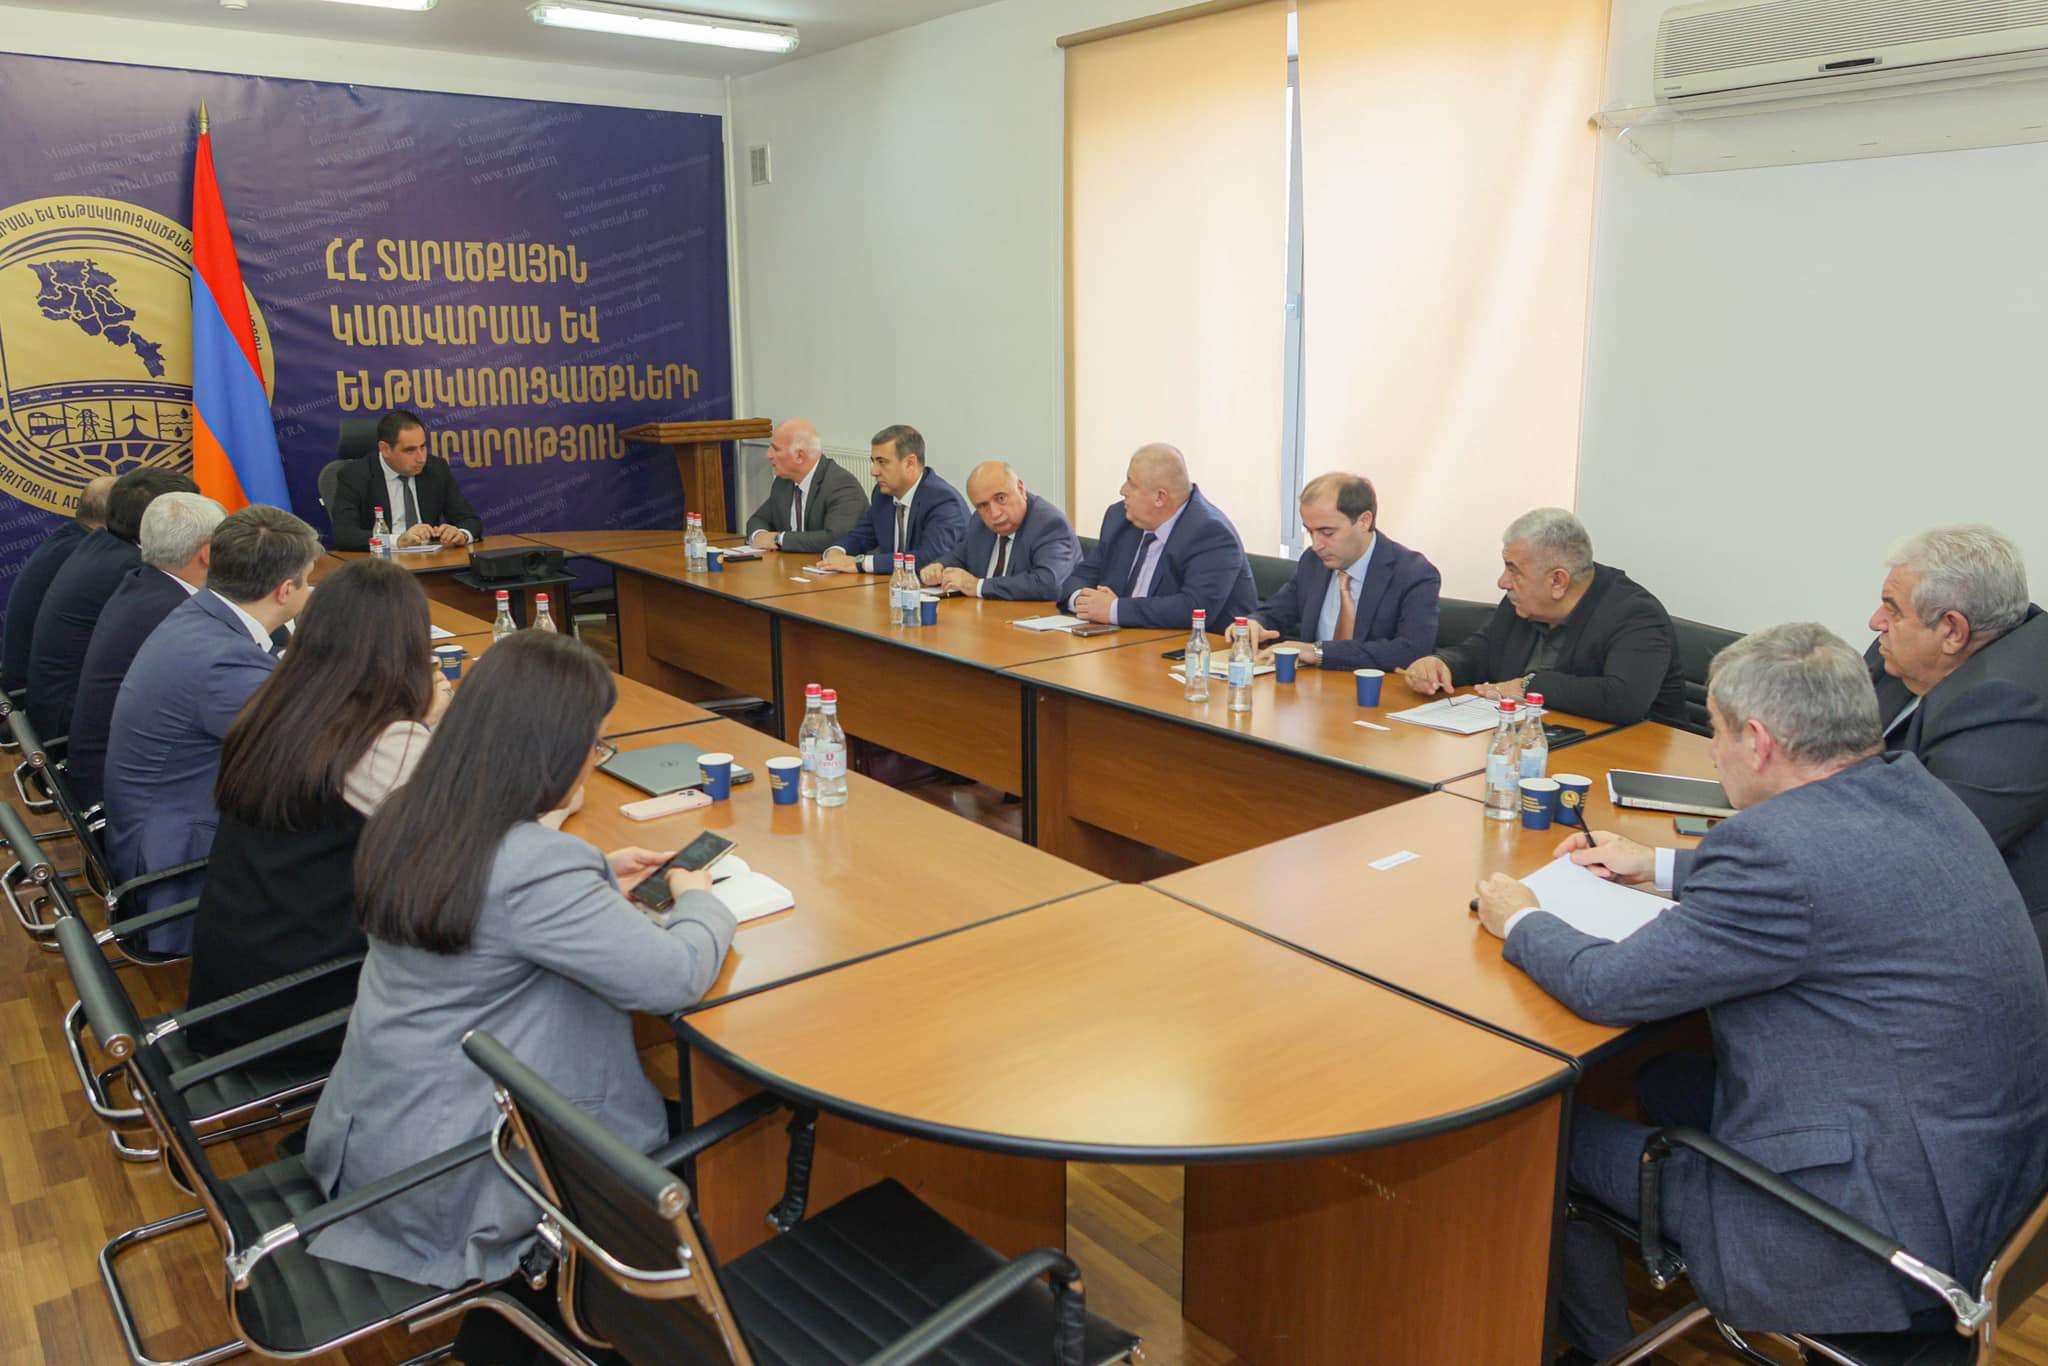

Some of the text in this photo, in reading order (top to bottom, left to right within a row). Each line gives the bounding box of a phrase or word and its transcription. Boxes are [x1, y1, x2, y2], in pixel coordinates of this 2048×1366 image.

[325, 237, 367, 282] ՀՀ
[375, 238, 588, 284] ՏԱՐԱԾՔԱՅԻՆ
[330, 304, 600, 346] ԿԱՌԱՎԱՐՄԱՆ ԵՎ
[336, 362, 700, 412] ԵՆԹԱԿԱՌՈՒՑՎԱԾՔՆԵՐԻ
[430, 423, 626, 469] ՐԱՐՈՒԹՅՈՒՆ
